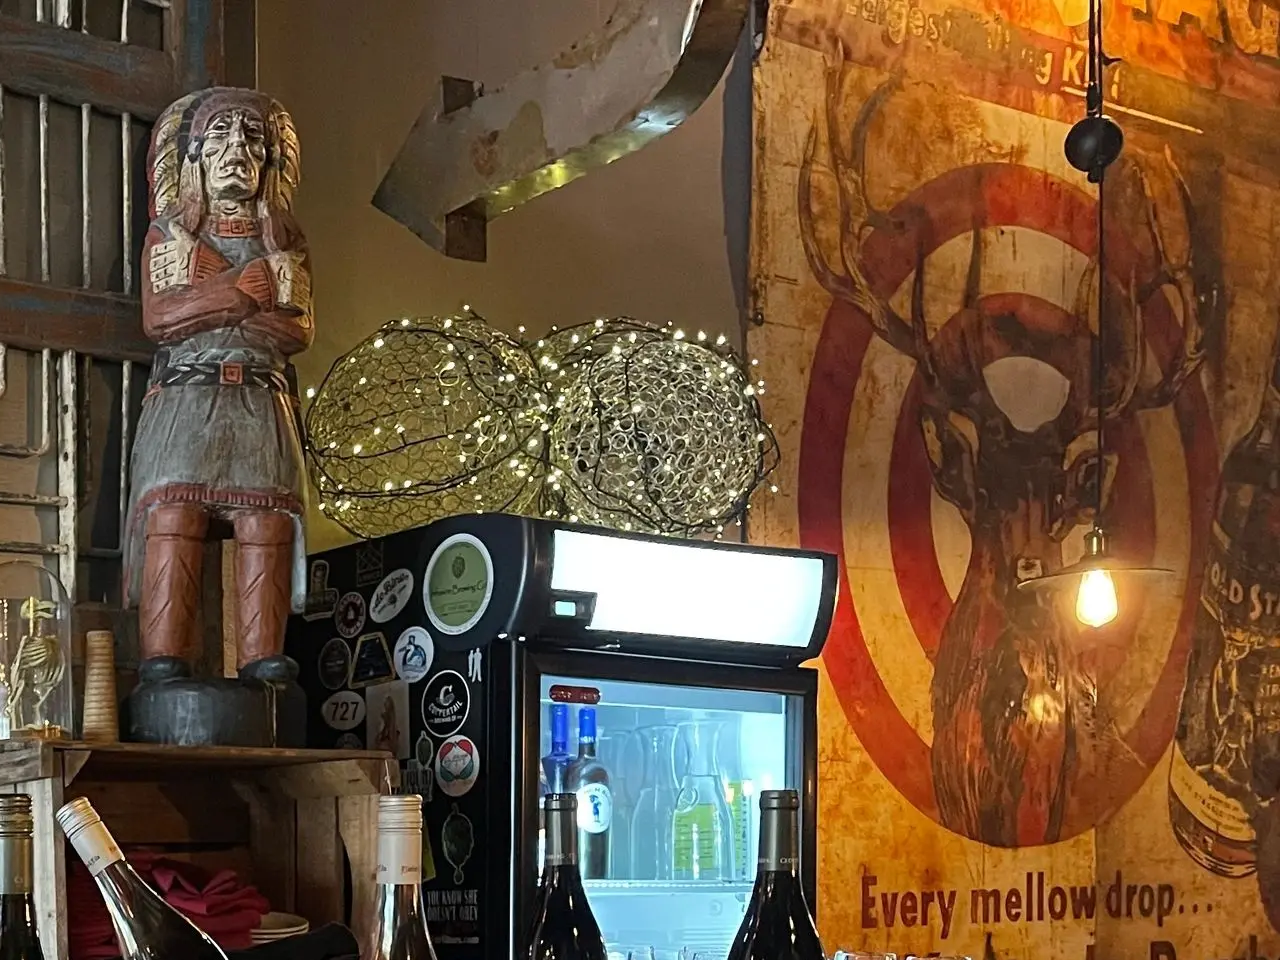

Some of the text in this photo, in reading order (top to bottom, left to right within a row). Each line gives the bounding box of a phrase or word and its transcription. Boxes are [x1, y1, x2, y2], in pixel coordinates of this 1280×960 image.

[331, 702, 360, 722] 727
[861, 872, 957, 940] Every
[971, 871, 1097, 924] mellow
